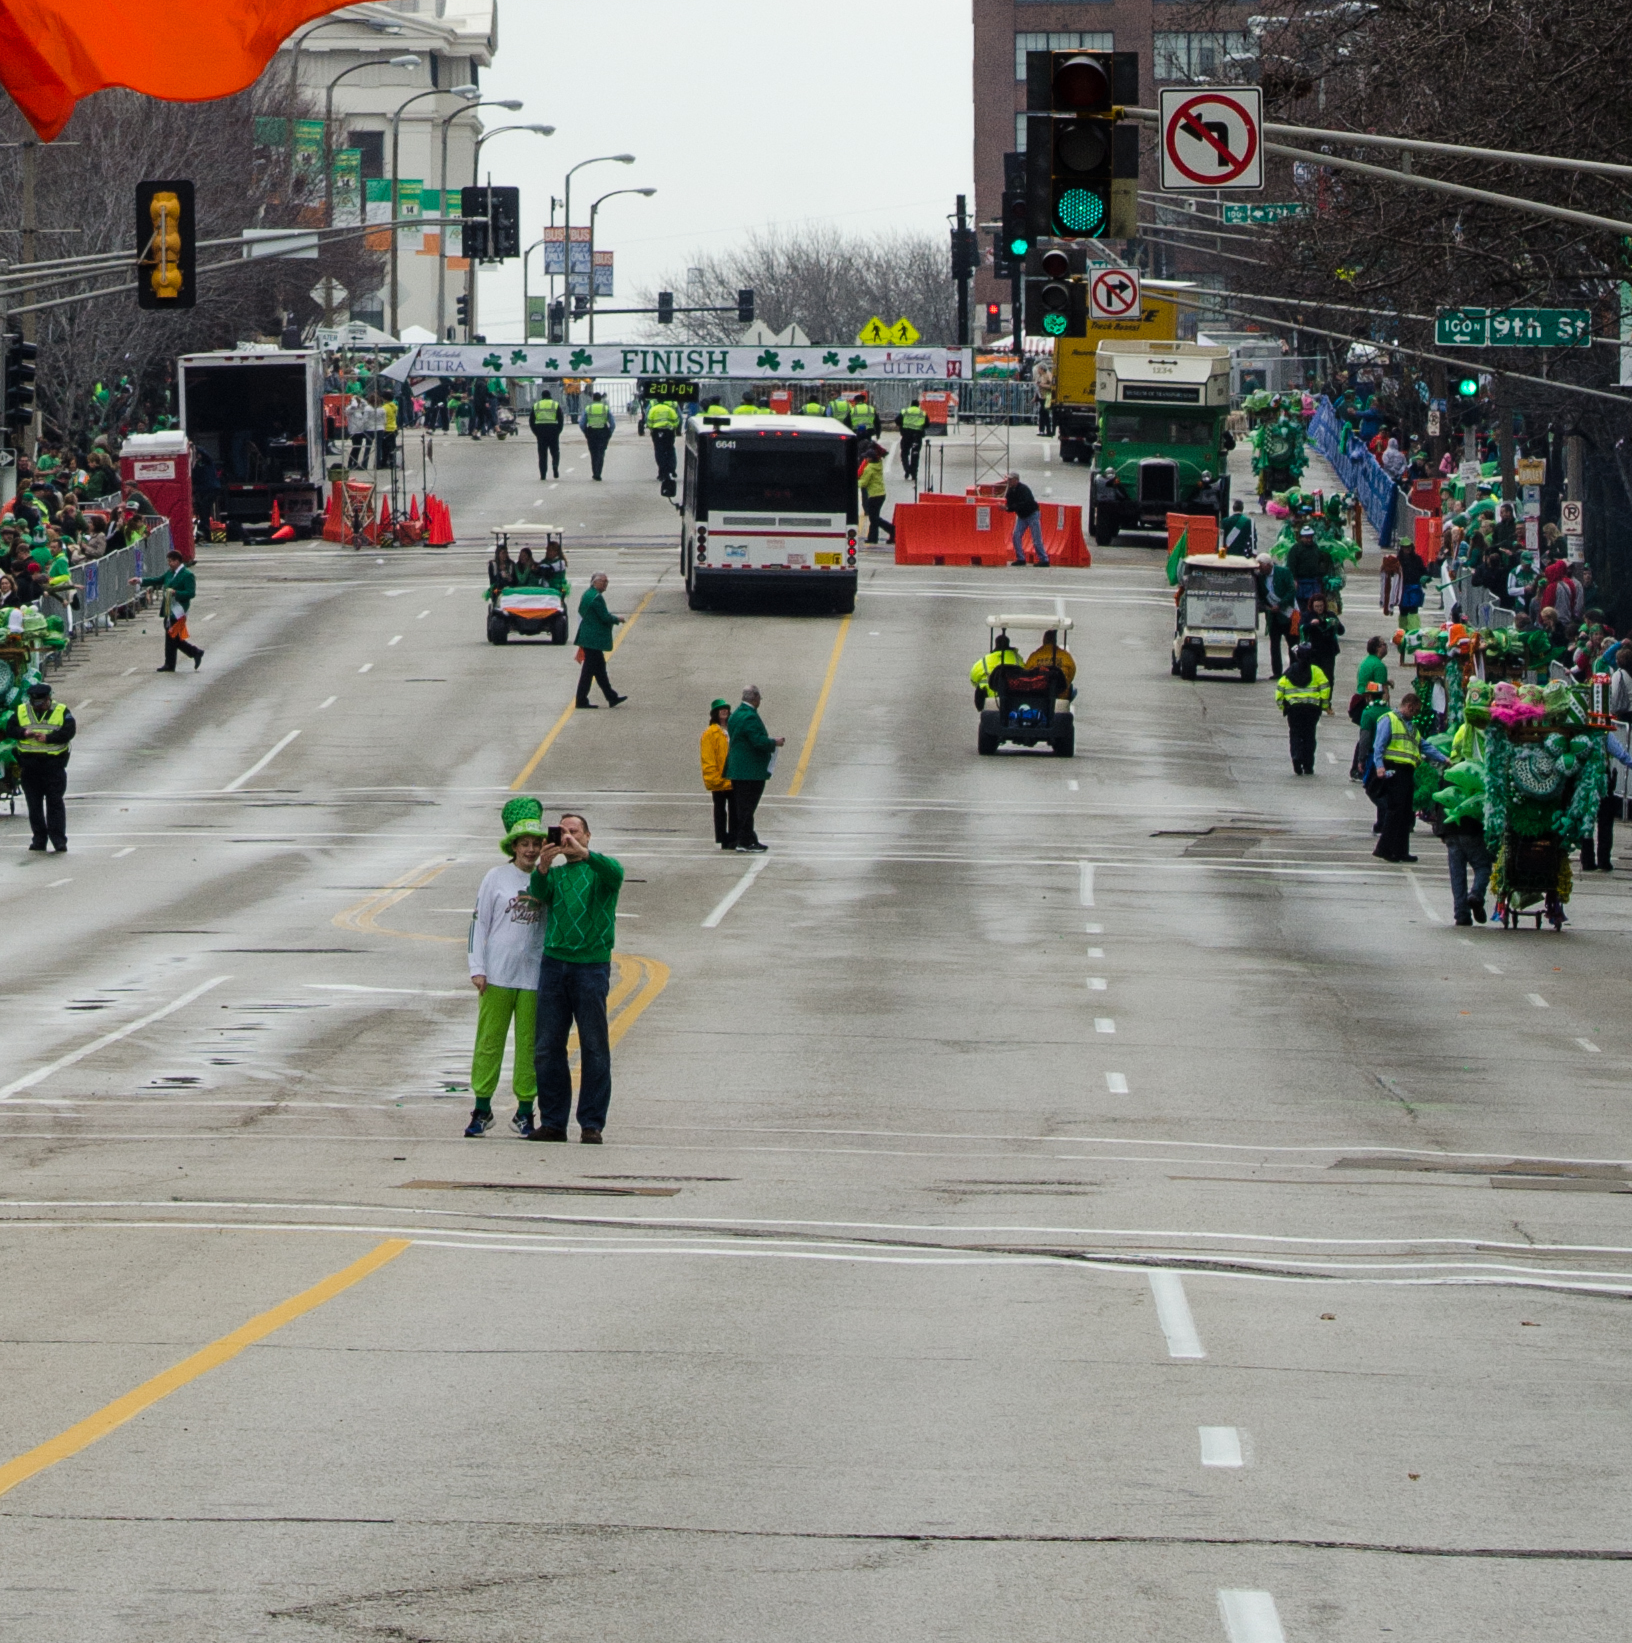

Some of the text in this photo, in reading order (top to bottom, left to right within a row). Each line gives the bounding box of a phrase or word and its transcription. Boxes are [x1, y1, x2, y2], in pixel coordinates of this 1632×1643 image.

[545, 228, 565, 241] BUS
[570, 228, 590, 241] BUS
[593, 254, 613, 265] BUS
[1493, 316, 1586, 339] 9th St
[414, 360, 467, 372] ULTRA
[620, 349, 729, 375] FINISH
[883, 363, 937, 375] ULTRA
[715, 440, 737, 449] 6641
